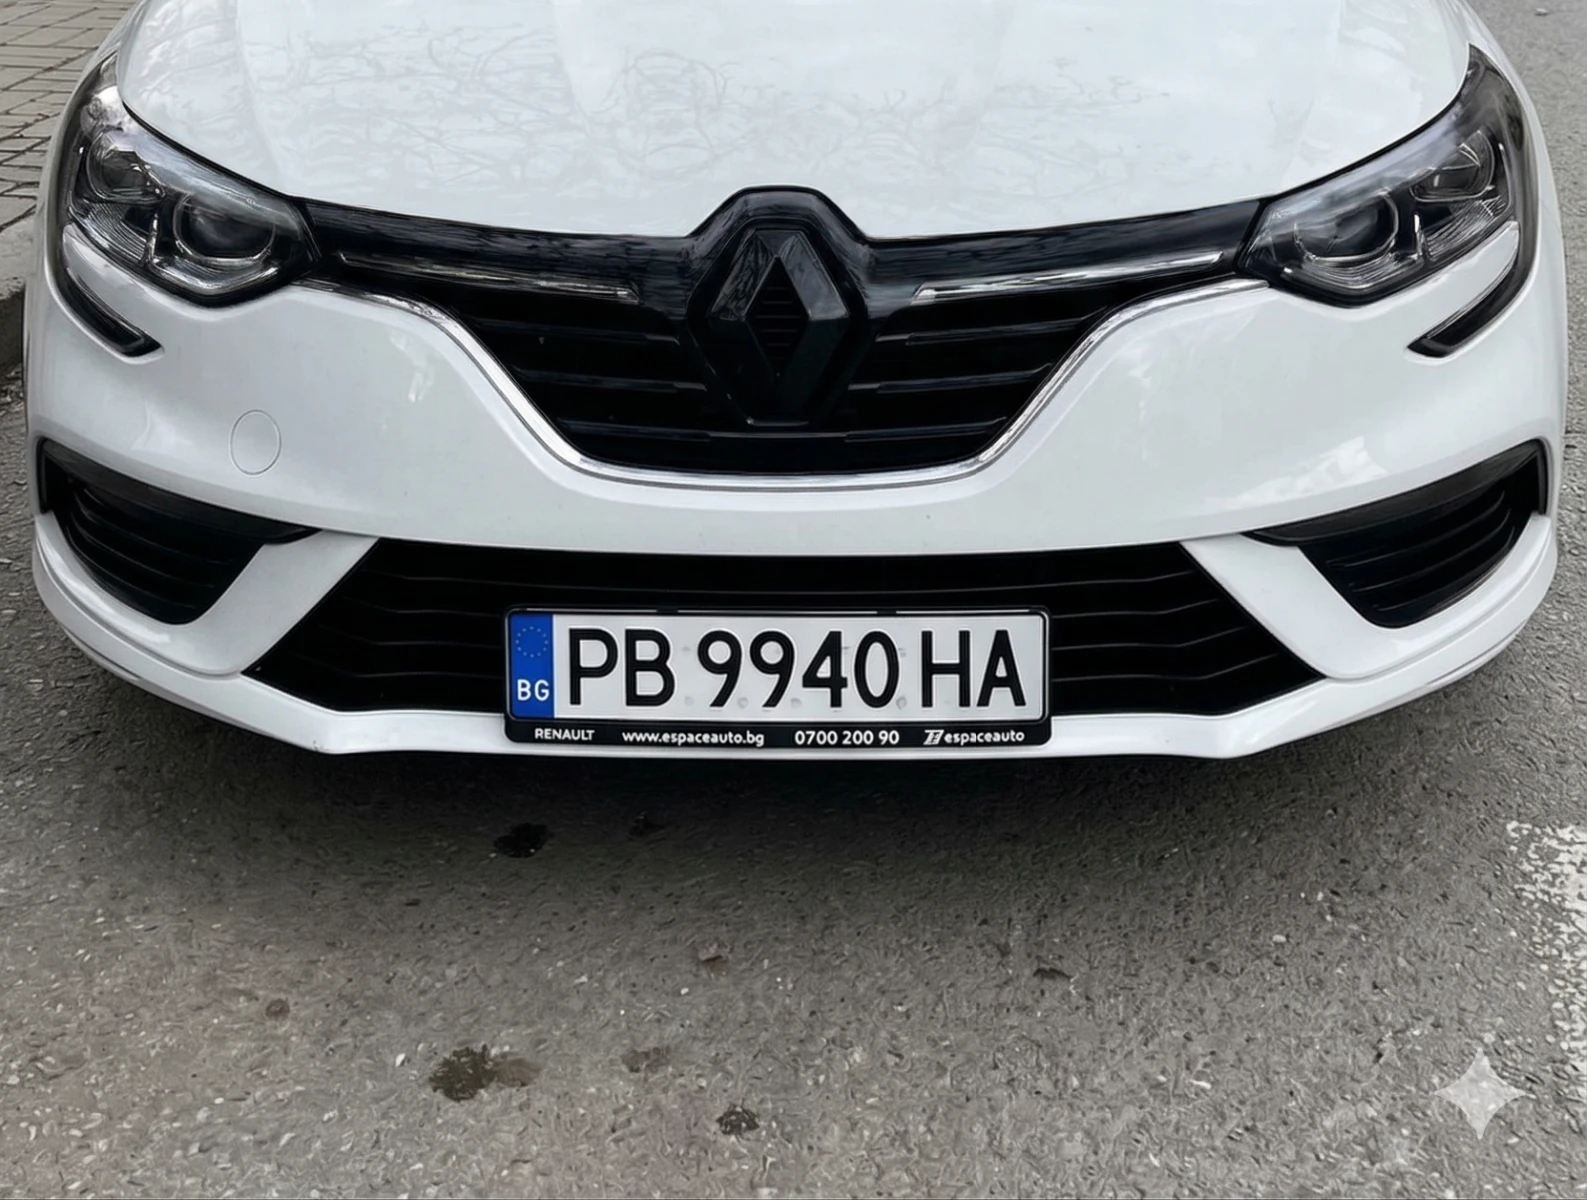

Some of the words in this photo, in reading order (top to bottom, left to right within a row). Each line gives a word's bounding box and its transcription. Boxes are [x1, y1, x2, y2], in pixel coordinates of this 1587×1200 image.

[569, 628, 676, 707] PB
[697, 630, 900, 708] 9940
[921, 629, 1027, 708] HA
[517, 679, 550, 701] BG
[534, 728, 595, 741] RENAULT
[622, 730, 765, 747] www.espaceauto.bg
[794, 730, 838, 745] 0700
[842, 730, 874, 745] 200
[879, 730, 900, 745] 90
[943, 729, 1026, 746] espaceauto
